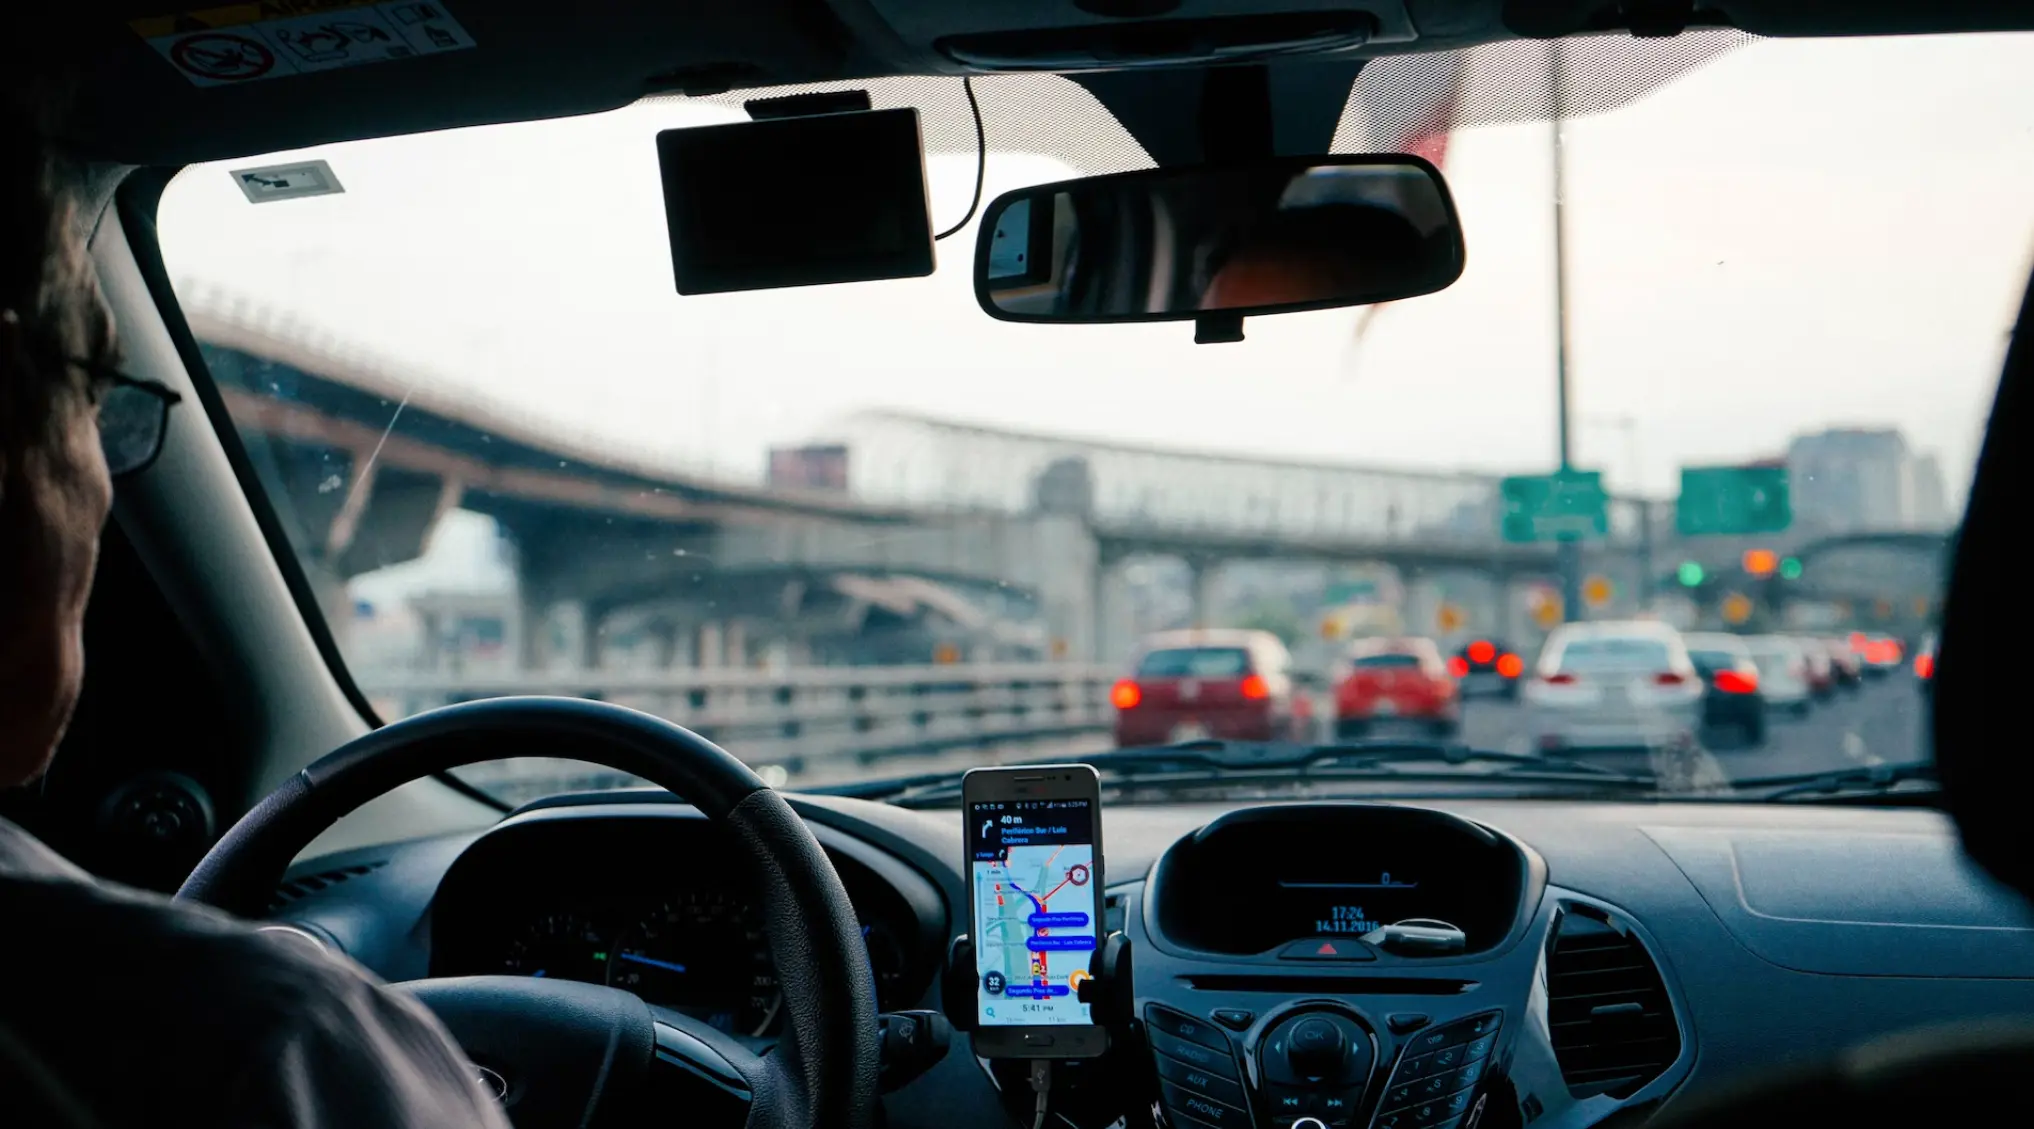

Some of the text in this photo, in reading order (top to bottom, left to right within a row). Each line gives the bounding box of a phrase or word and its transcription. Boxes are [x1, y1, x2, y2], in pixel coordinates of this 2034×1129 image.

[1000, 815, 1022, 824] 40 m
[1001, 836, 1029, 844] Cabrera
[1331, 905, 1364, 920] 17:24
[988, 977, 1000, 986] 32
[1022, 1004, 1040, 1012] 5:41
[1179, 1024, 1195, 1035] CD
[1304, 1030, 1324, 1041] OK
[1176, 1045, 1211, 1063] RADIO
[1444, 1052, 1453, 1061] 2
[1466, 1067, 1474, 1076] 6
[1186, 1073, 1209, 1088] AUX
[1433, 1079, 1441, 1088] 5
[1455, 1095, 1463, 1104] 9
[1186, 1098, 1224, 1120] PHONE
